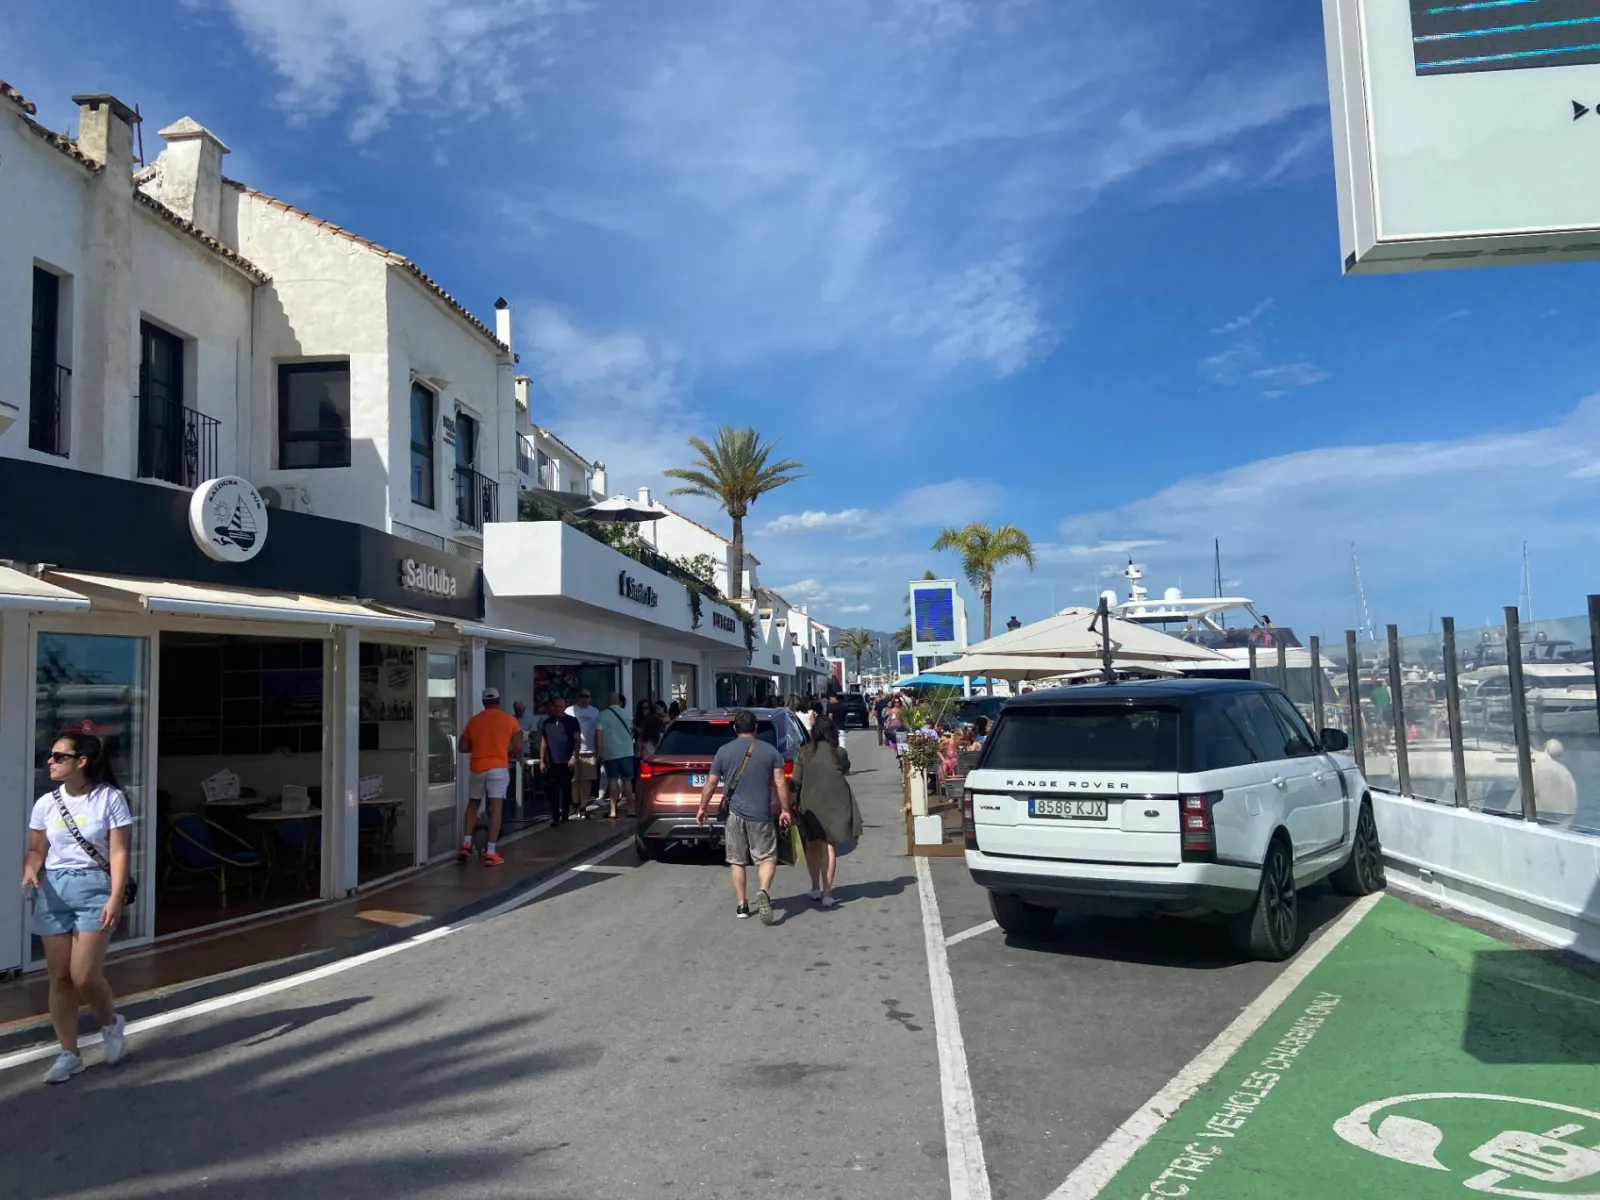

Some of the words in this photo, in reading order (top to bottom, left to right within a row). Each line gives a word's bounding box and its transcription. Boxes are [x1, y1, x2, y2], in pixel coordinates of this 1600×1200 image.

[209, 480, 238, 502] SALDUBA
[250, 490, 261, 509] PUB
[405, 558, 456, 596] Salduba
[1007, 780, 1057, 788] RANGE
[1069, 781, 1129, 789] ROVER
[1038, 801, 1072, 814] 8586
[1077, 801, 1104, 815] KJX
[1196, 1071, 1280, 1137] VEHICLES
[1261, 1017, 1325, 1070] CHARGING
[1305, 992, 1342, 1016] ONLY
